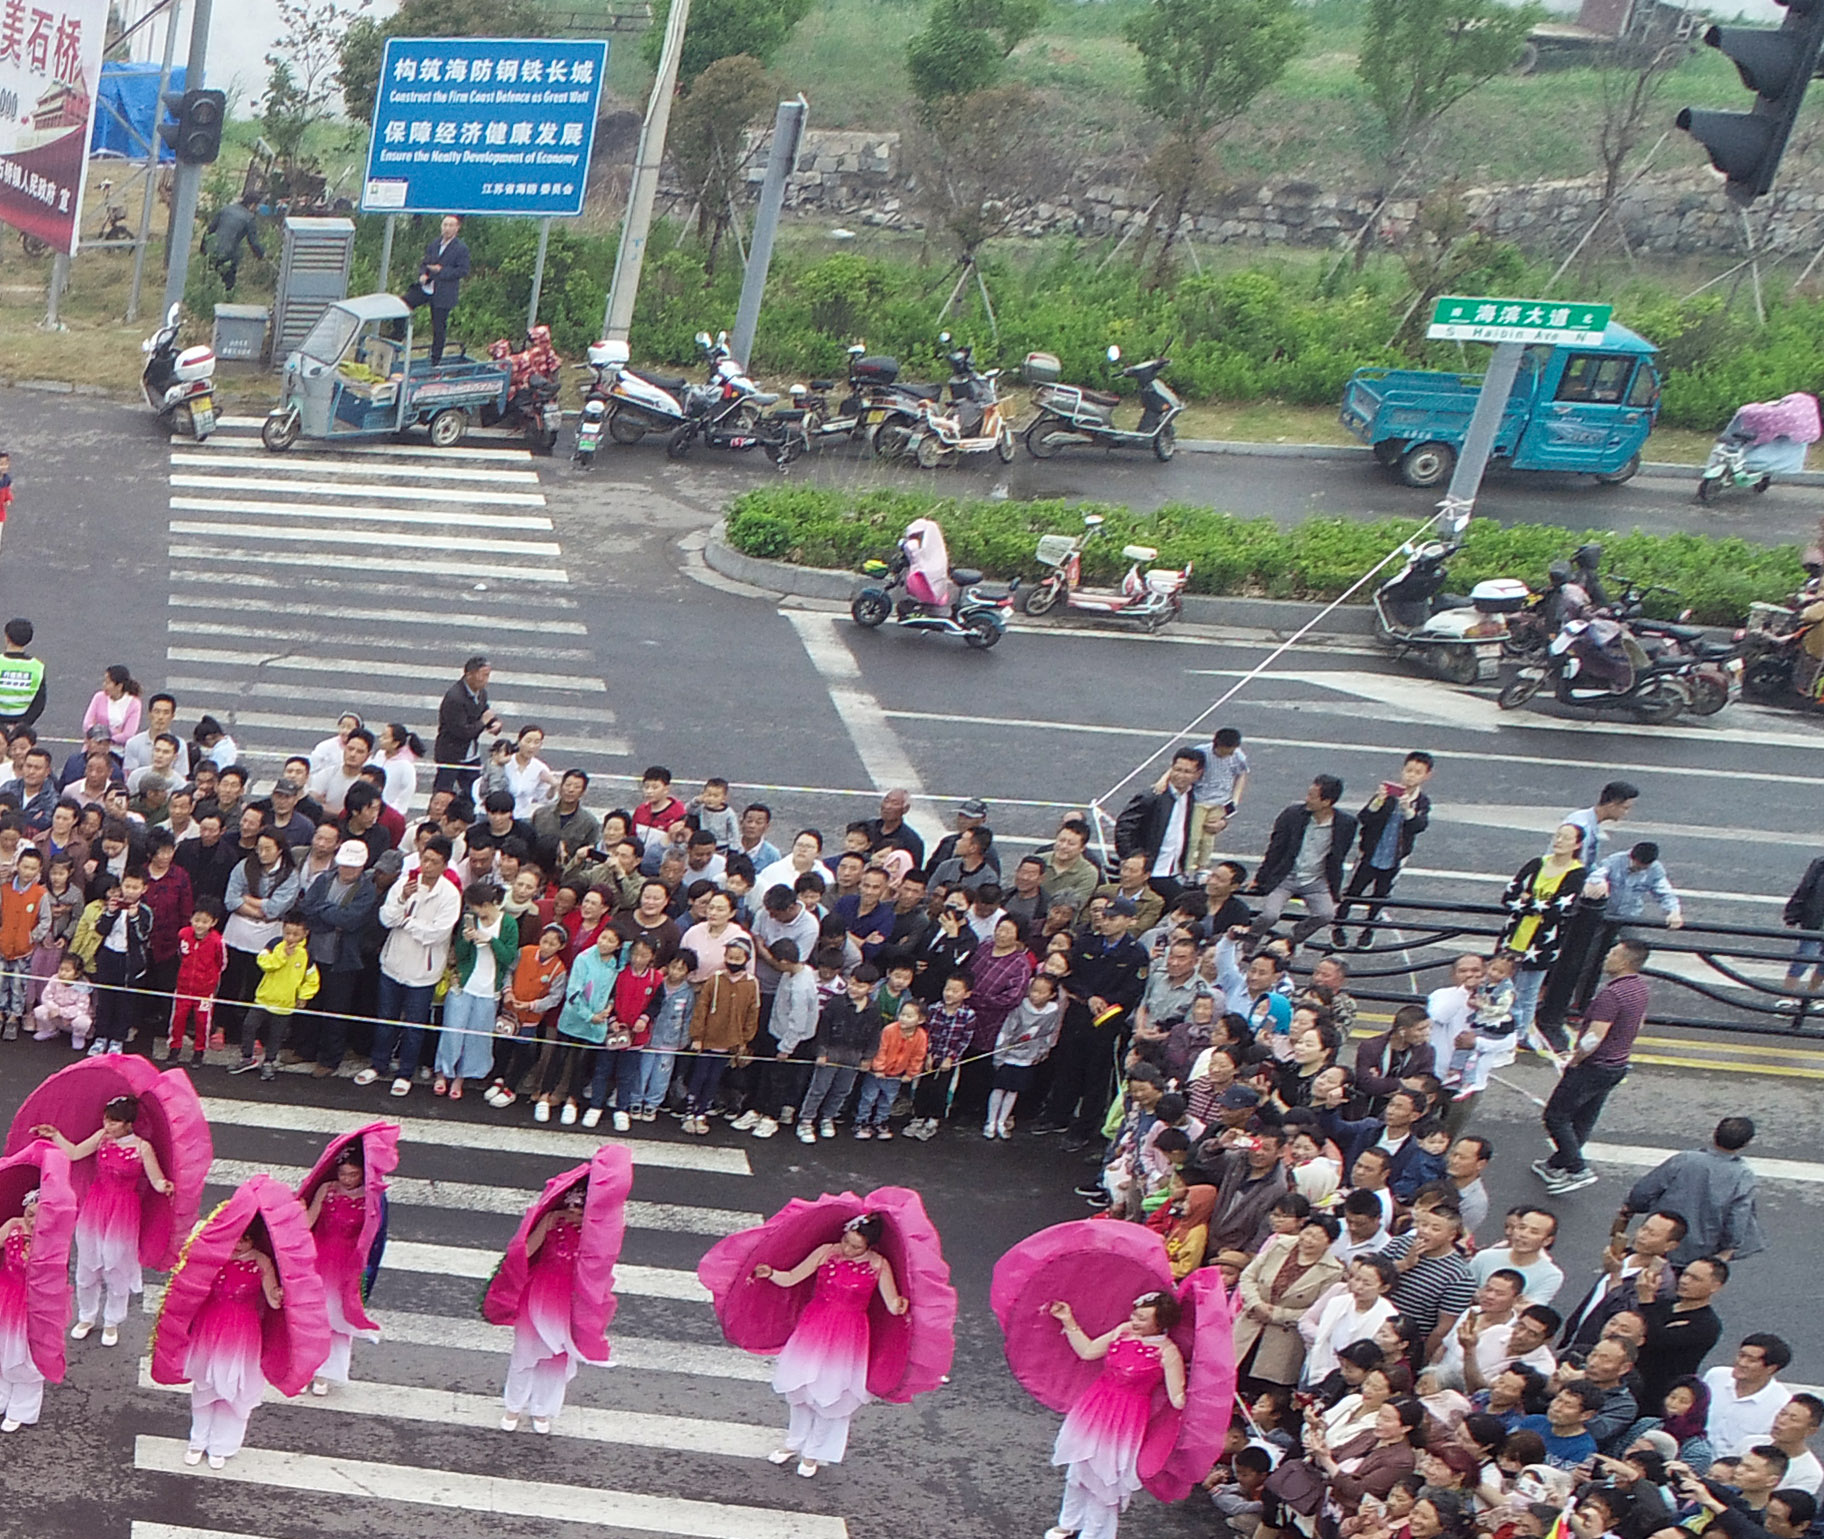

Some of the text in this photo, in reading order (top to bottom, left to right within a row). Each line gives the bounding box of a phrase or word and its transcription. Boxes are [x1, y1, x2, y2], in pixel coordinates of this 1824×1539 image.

[393, 57, 594, 84] 构筑海防钢铁长城
[390, 88, 432, 103] Construct
[433, 90, 448, 103] the
[448, 90, 469, 103] Firm
[543, 89, 568, 103] Great
[384, 120, 584, 146] 保障经济健康发展
[380, 149, 412, 162] Ensure
[413, 149, 430, 162] the
[462, 150, 524, 166] Development
[536, 151, 579, 167] Economy
[1473, 304, 1572, 327] 海滨大道
